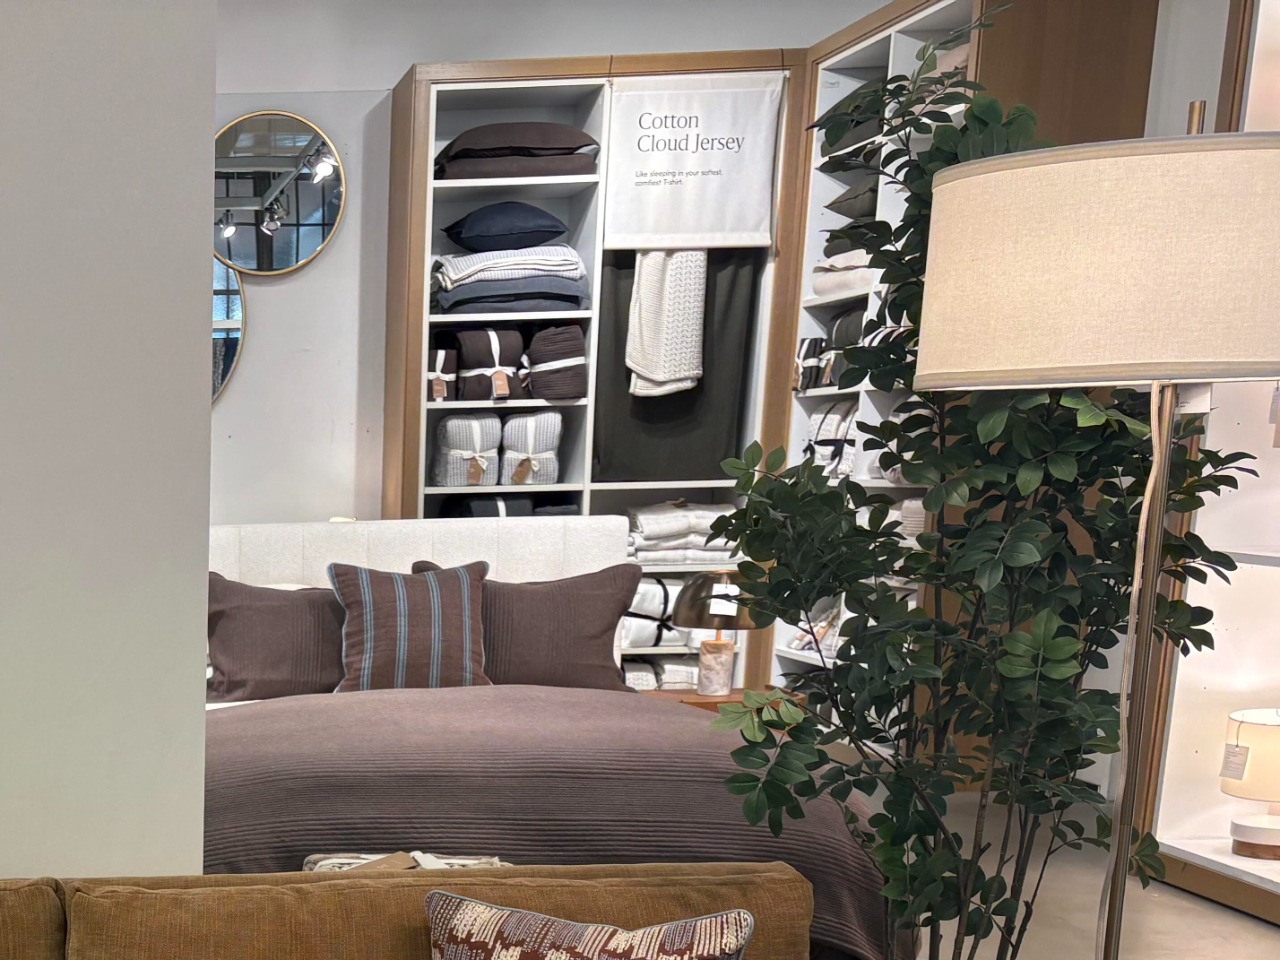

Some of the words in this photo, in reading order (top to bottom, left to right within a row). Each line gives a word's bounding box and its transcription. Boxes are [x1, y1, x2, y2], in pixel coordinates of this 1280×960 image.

[638, 112, 699, 130] Cotton
[637, 134, 689, 152] Cloud
[691, 133, 745, 154] Jersey
